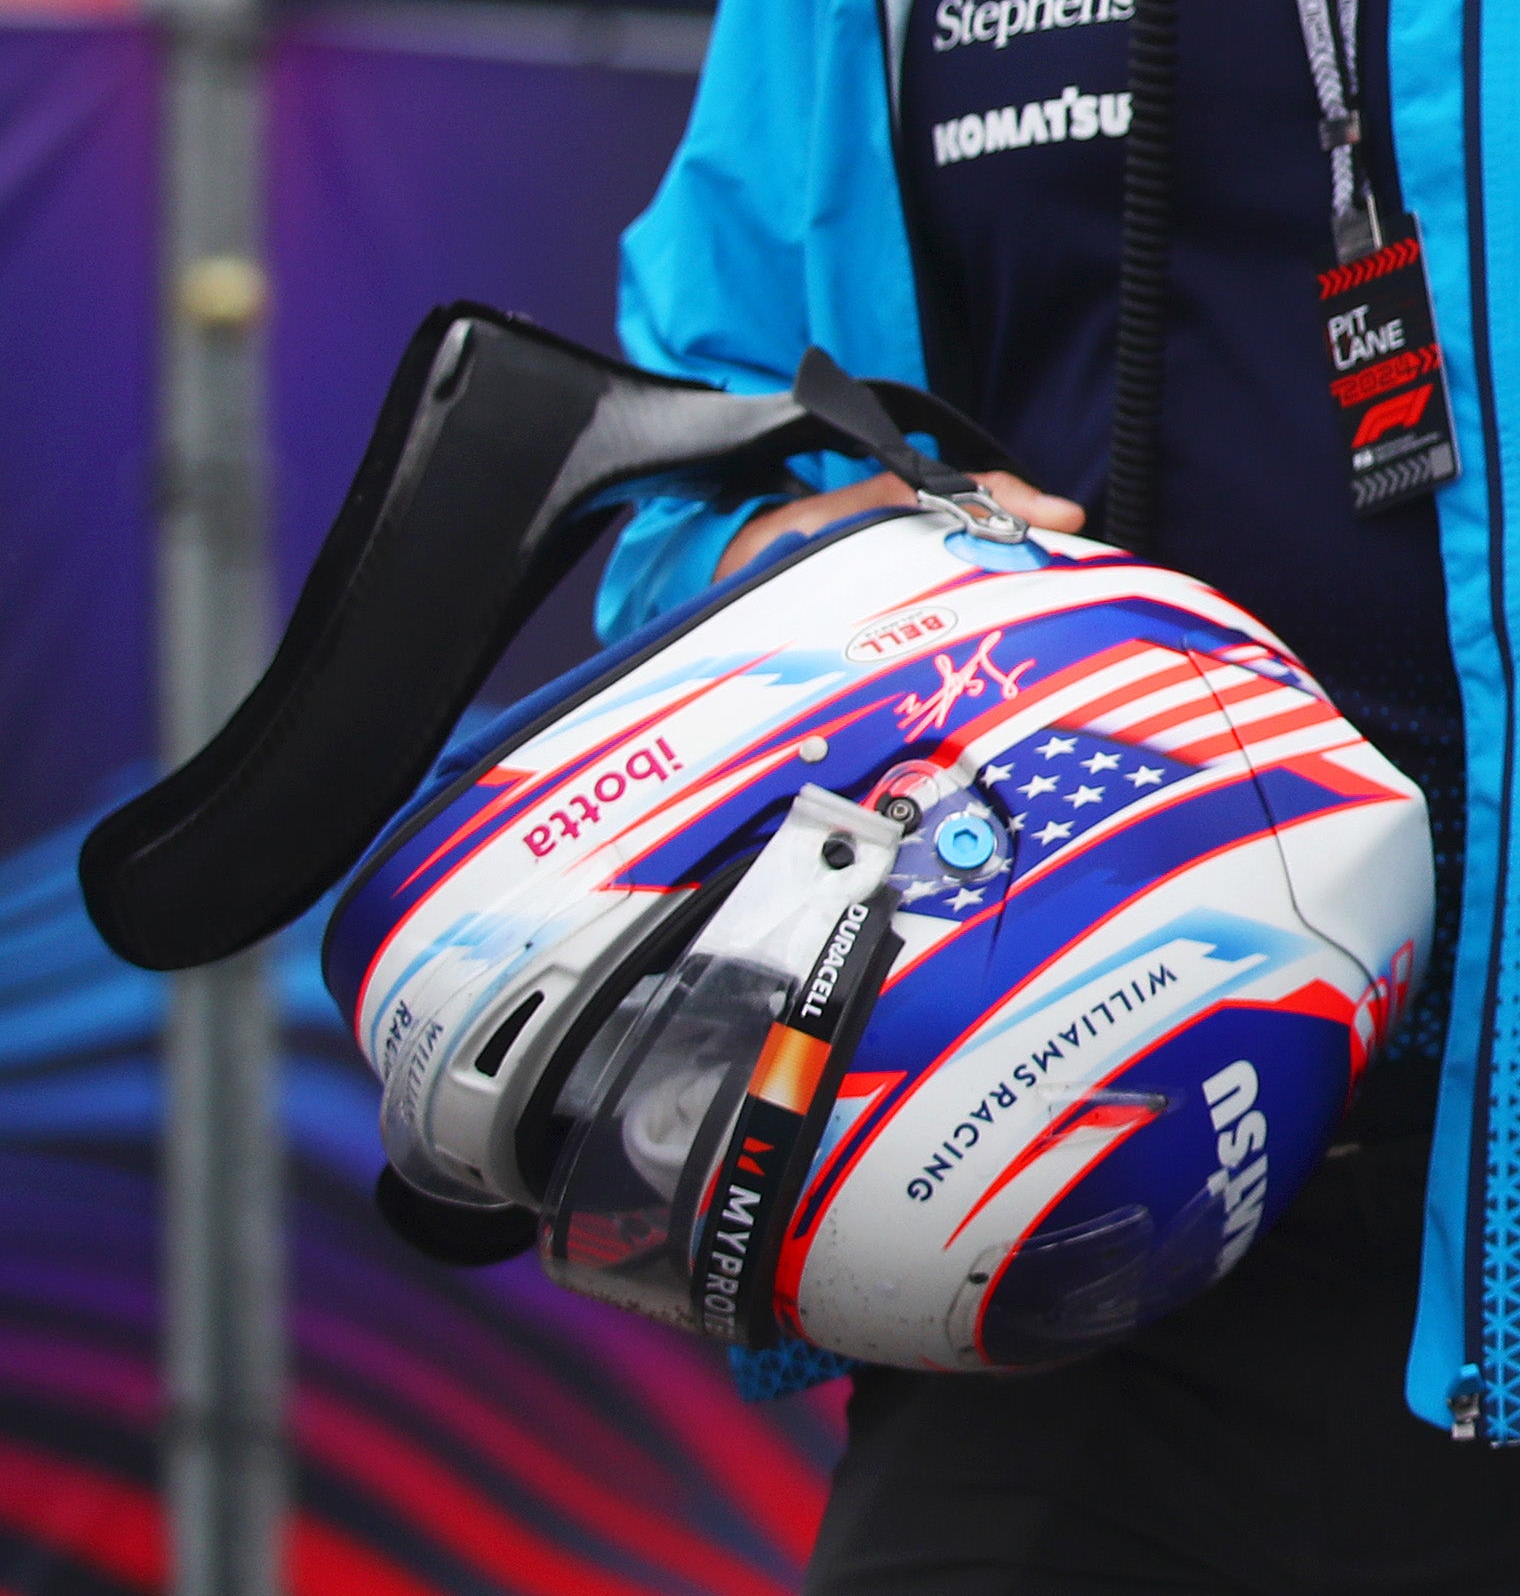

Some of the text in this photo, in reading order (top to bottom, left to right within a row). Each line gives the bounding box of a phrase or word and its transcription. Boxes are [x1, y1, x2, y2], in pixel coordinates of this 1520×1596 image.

[933, 85, 1134, 166] KOMATSU
[1328, 305, 1369, 343] PIT
[1332, 319, 1406, 371] LANE
[860, 613, 946, 654] BELL
[521, 736, 686, 860] ibotta
[800, 902, 869, 1019] DURACELL
